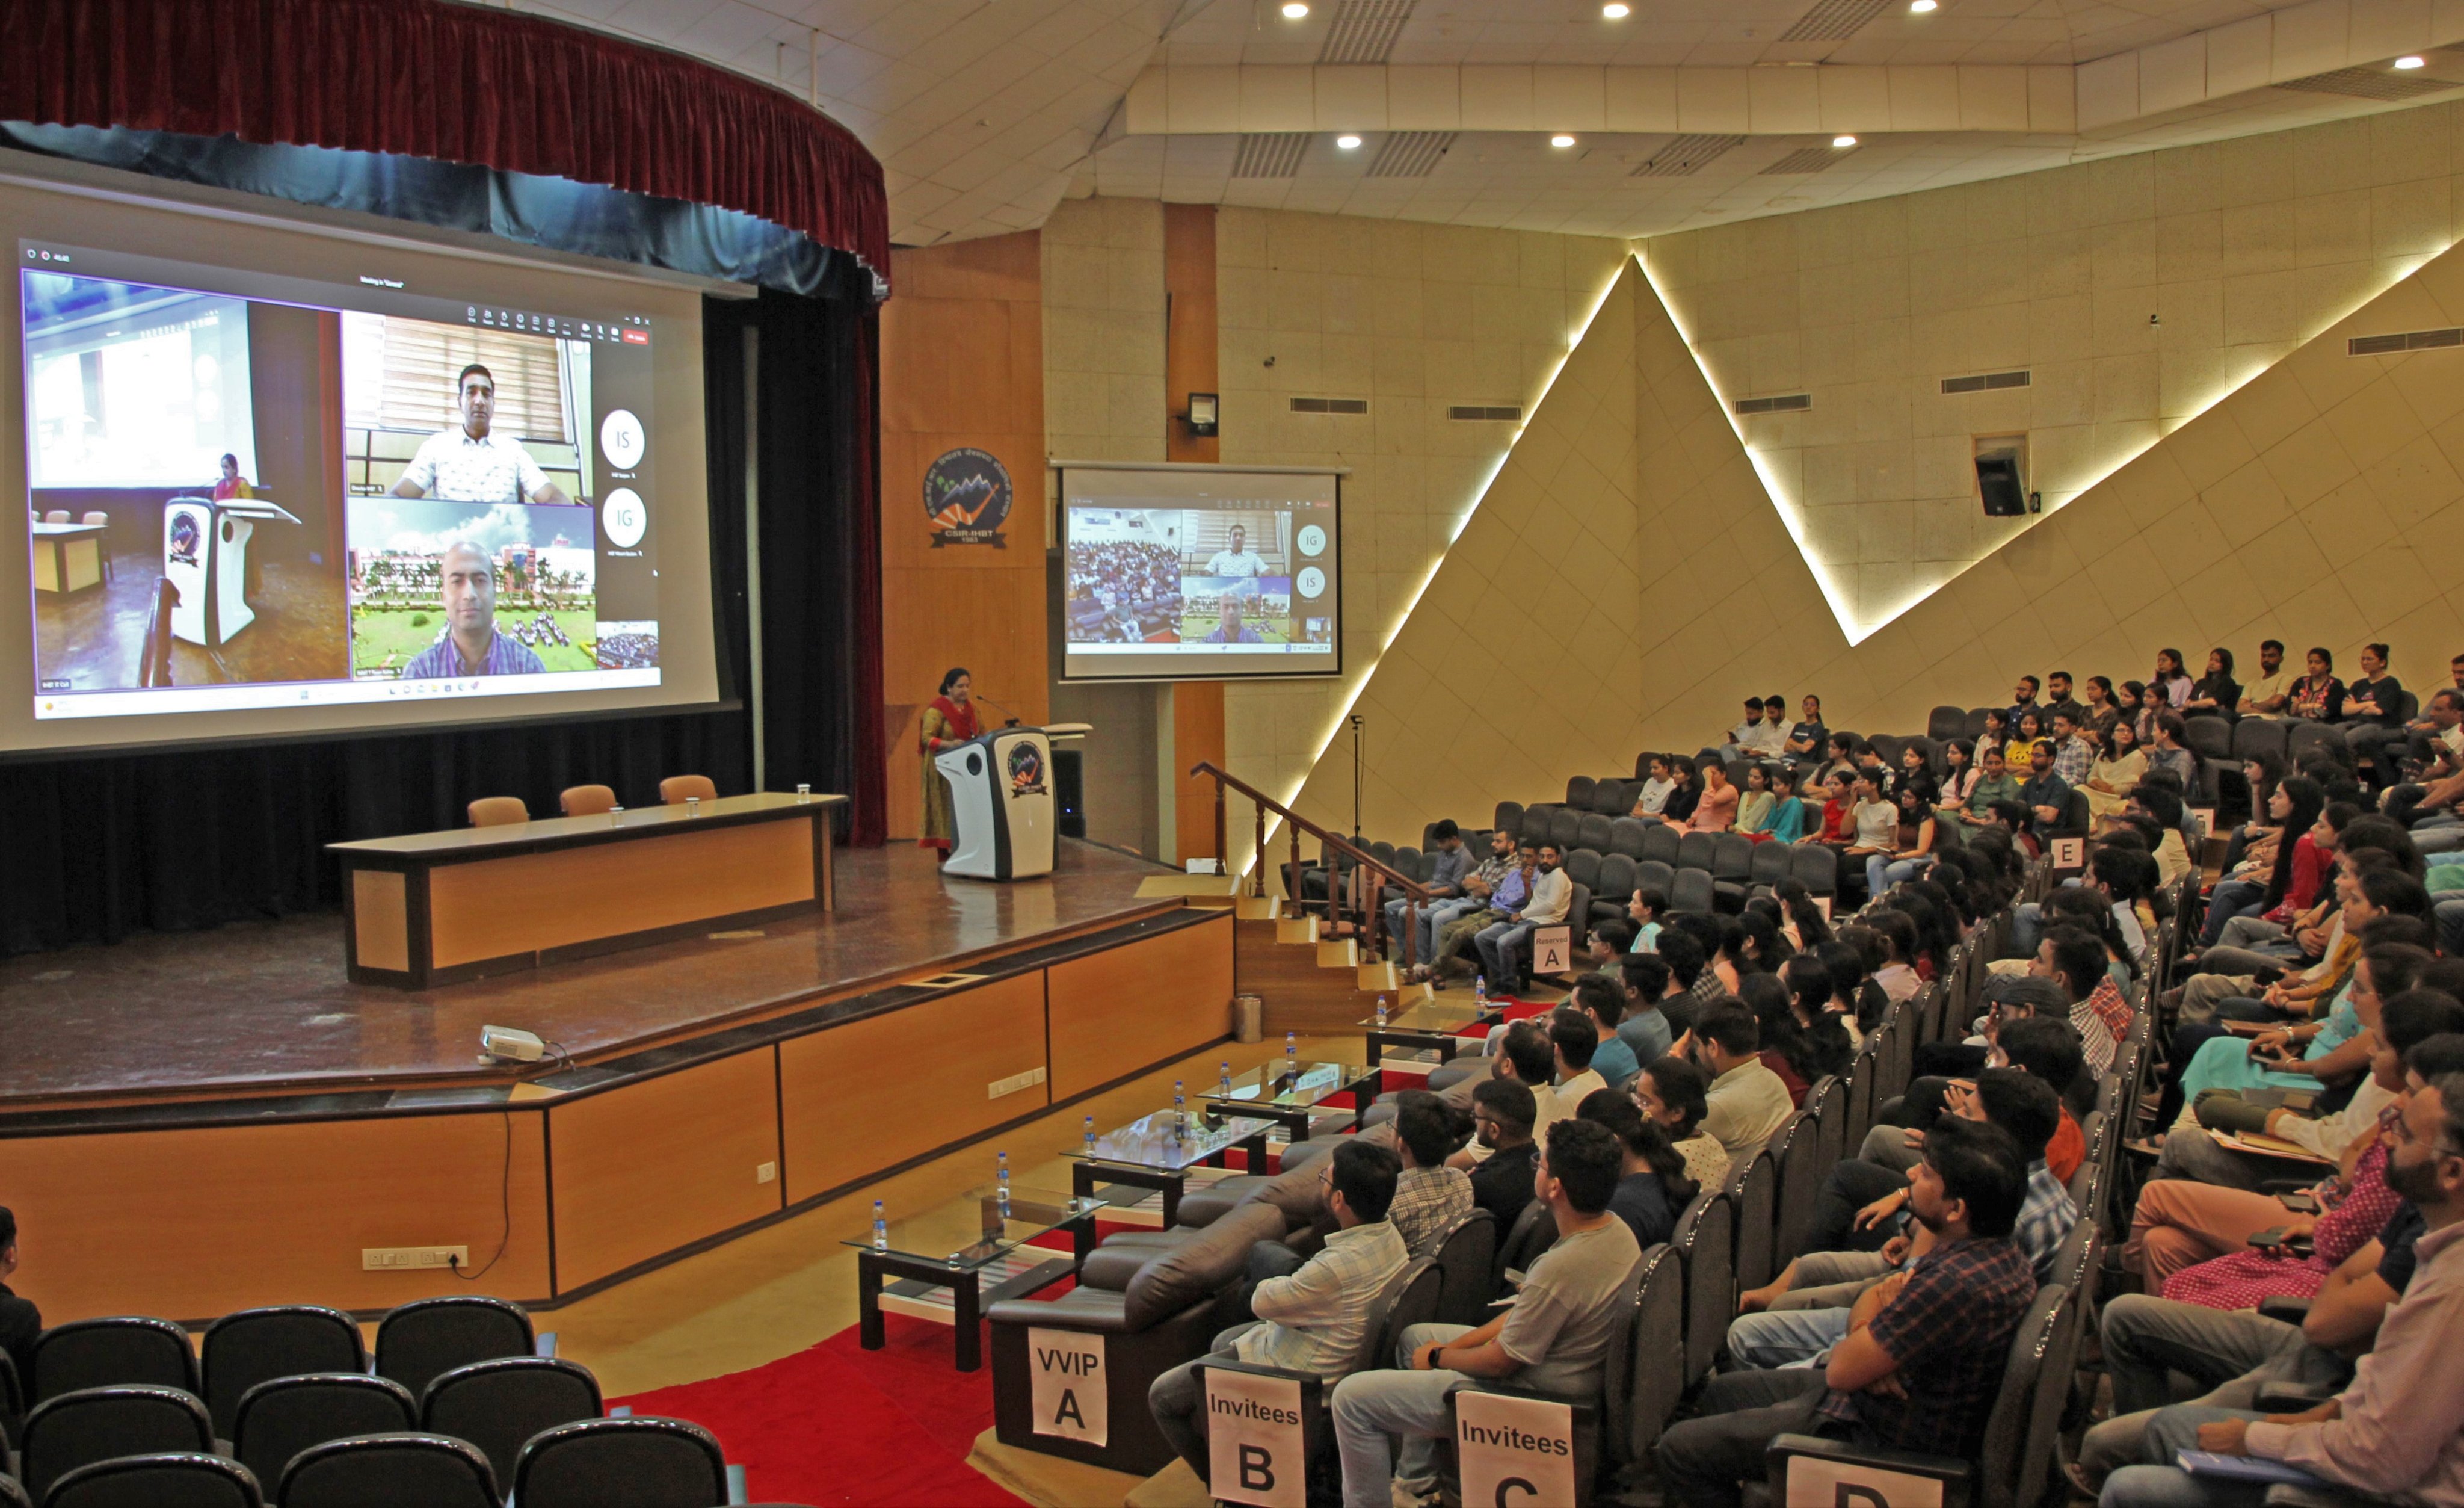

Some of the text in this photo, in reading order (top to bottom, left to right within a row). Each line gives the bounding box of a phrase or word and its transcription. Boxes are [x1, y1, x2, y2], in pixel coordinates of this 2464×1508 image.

[617, 431, 630, 448] IS
[617, 510, 632, 527] IG
[1306, 535, 1317, 546] IG
[1306, 578, 1316, 587] IS
[2062, 844, 2072, 862] E
[1536, 936, 1568, 945] Reserved
[1545, 948, 1559, 967] A
[1037, 1347, 1098, 1376] VVIP
[1055, 1388, 1086, 1429] A
[1211, 1393, 1299, 1425] Invitees
[1462, 1420, 1568, 1456] Invitees
[1239, 1442, 1275, 1492] B
